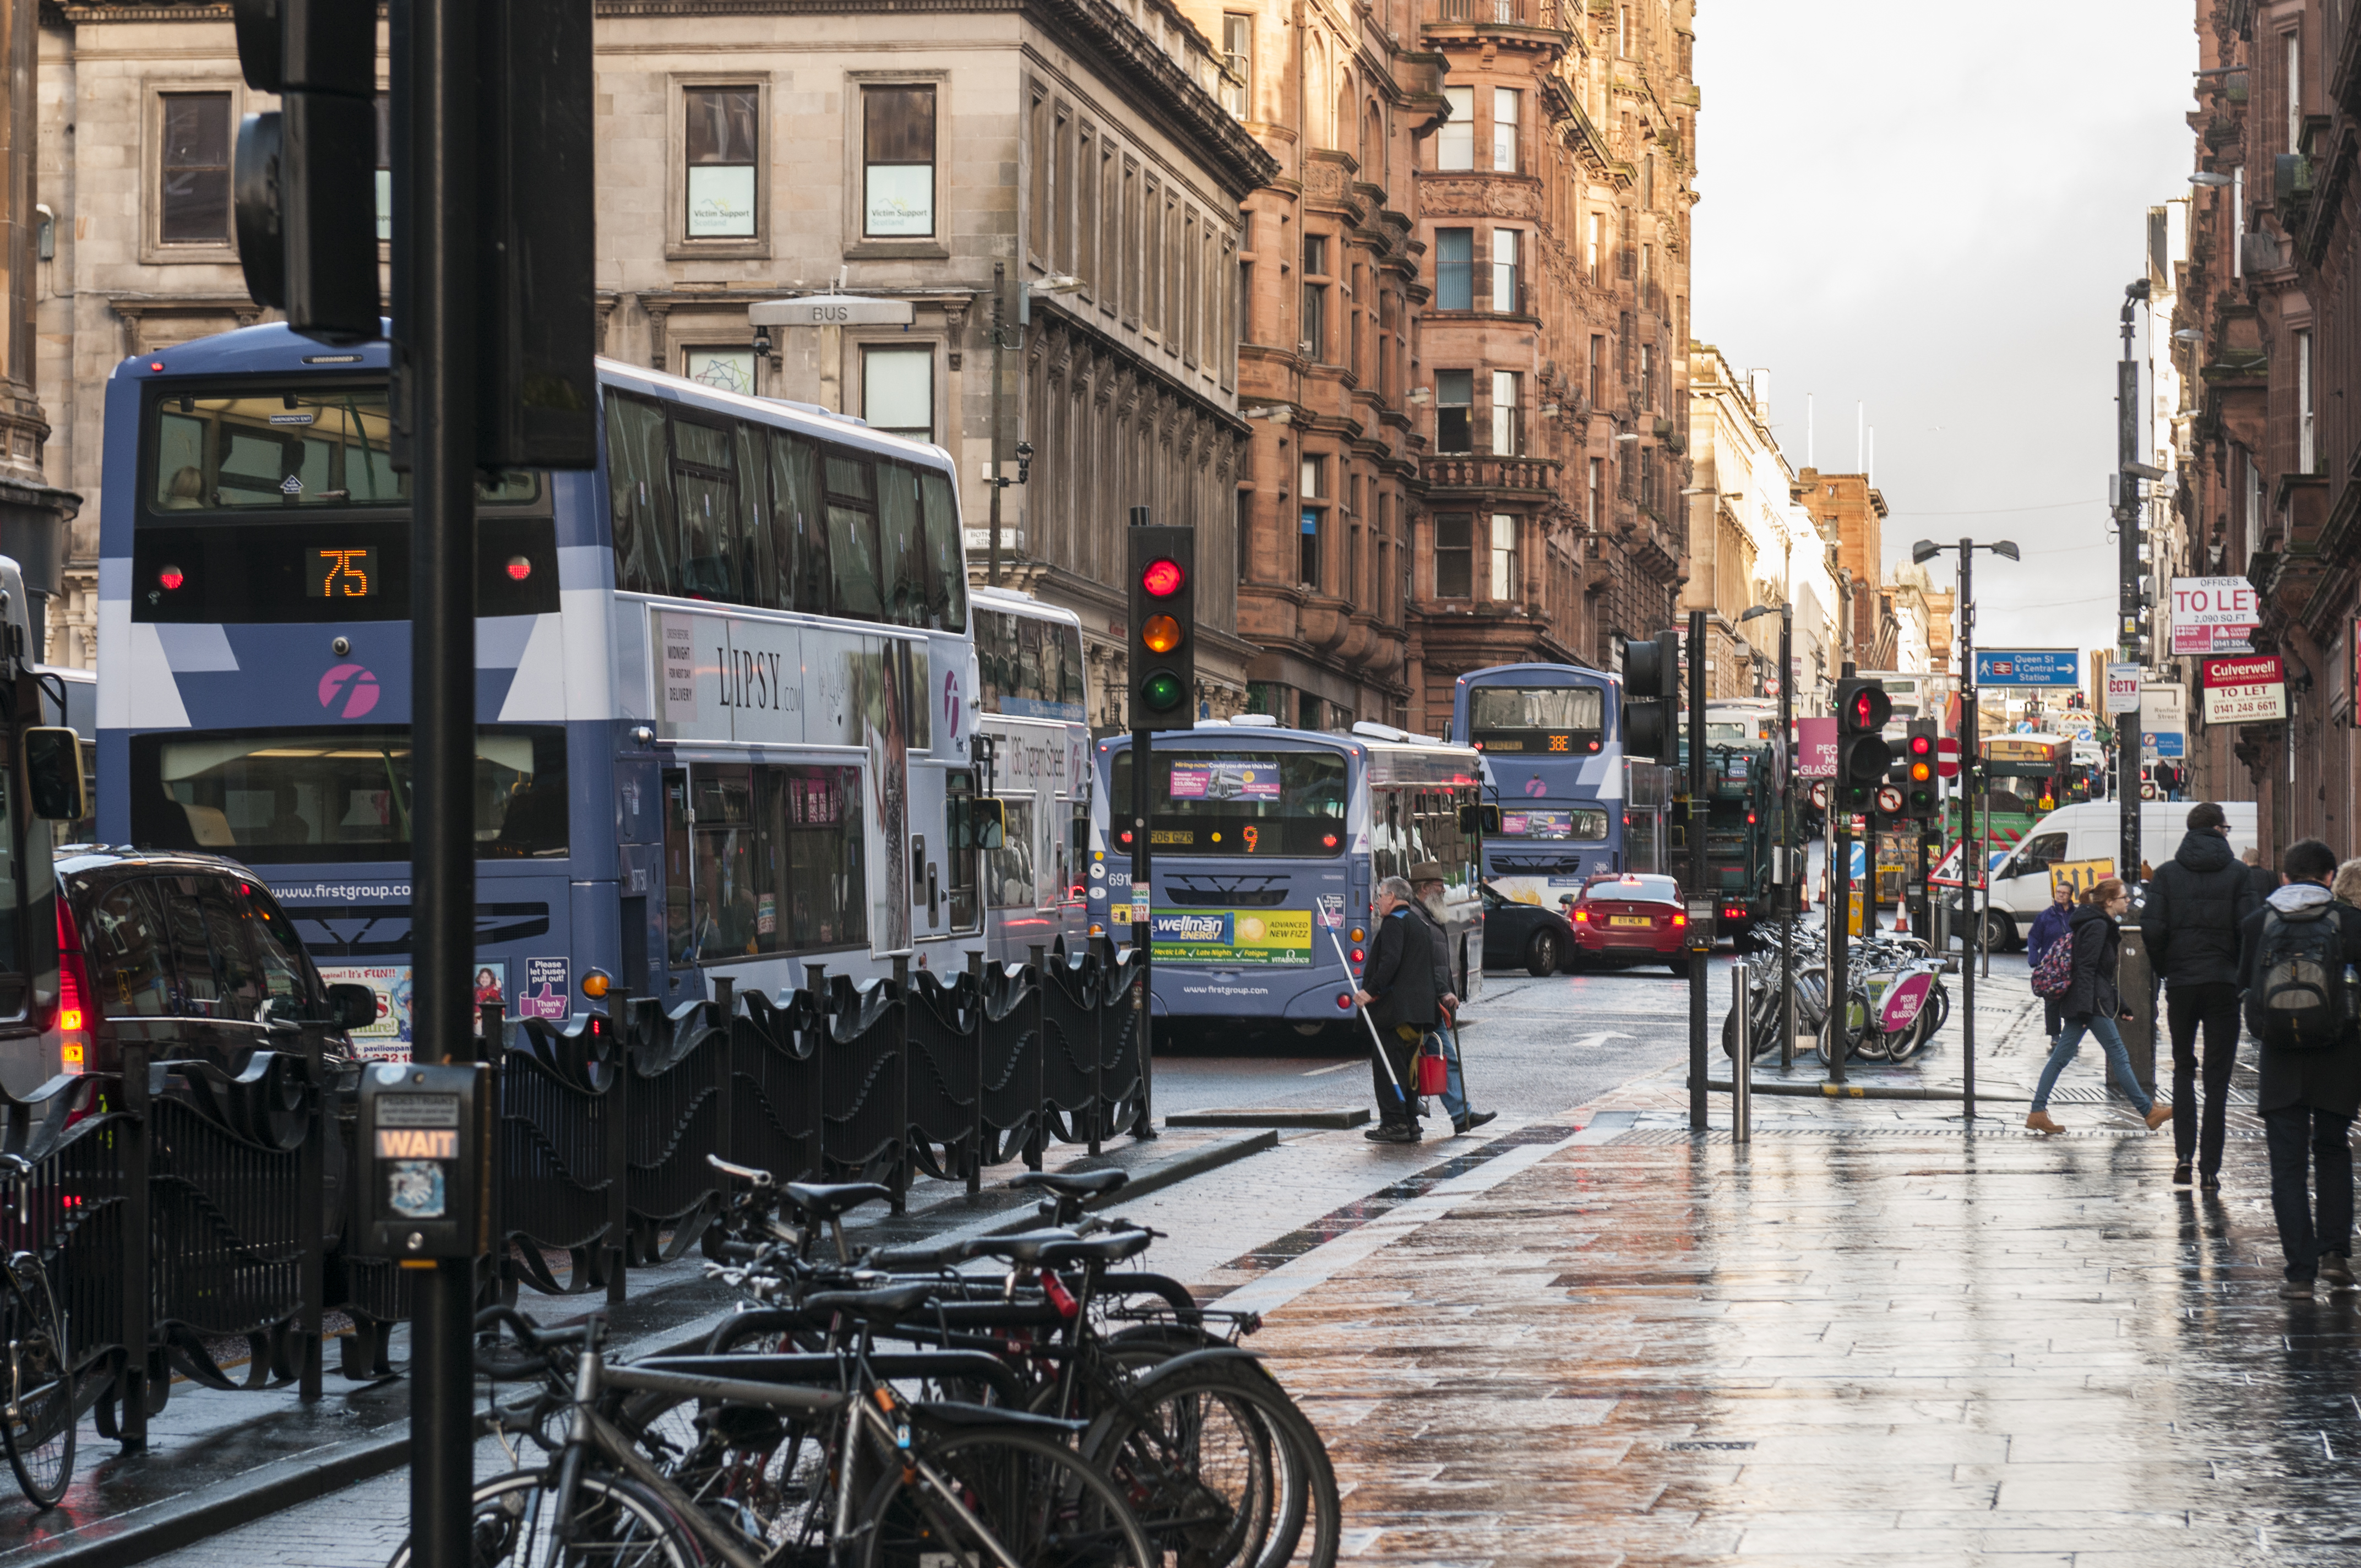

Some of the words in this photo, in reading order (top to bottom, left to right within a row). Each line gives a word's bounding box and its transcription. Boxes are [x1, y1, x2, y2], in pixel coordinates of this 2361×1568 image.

[720, 210, 749, 219] Support
[897, 209, 928, 218] Support
[813, 307, 847, 320] BUS
[320, 551, 367, 597] 75
[2200, 579, 2238, 587] OFFICES
[2174, 590, 2208, 612] TO
[2217, 590, 2259, 611] LET
[2195, 615, 2218, 623] 2,090
[2221, 614, 2246, 622] SQ.FT
[668, 645, 690, 660] MIDNIGHT
[2015, 655, 2042, 663] Queen
[2023, 664, 2054, 672] Central
[2211, 660, 2275, 676] Culverwell
[2109, 680, 2136, 693] CCTV
[2220, 688, 2237, 697] TO
[2244, 686, 2267, 696] LET
[670, 687, 692, 702] DELIVERY
[2214, 704, 2233, 714] 0141
[2237, 703, 2253, 712] 248
[2257, 701, 2276, 710] 6611
[1549, 736, 1569, 750] 38E
[1816, 744, 1837, 754] PEO
[1046, 738, 1065, 777] Street
[1800, 765, 1837, 775] GLASG
[1244, 826, 1258, 852] 9
[272, 884, 411, 900] www.firstgroup.co
[1180, 930, 1220, 940] ENERGY
[1290, 930, 1308, 938] FIZZ
[1211, 949, 1232, 957] Nights
[1244, 950, 1268, 958] Fatigue
[349, 970, 361, 978] It's
[363, 968, 395, 978] FUN!!
[532, 975, 547, 984] pull
[1184, 986, 1268, 996] www.firstgroup.com
[536, 999, 561, 1008] Thank
[1900, 994, 1918, 1003] PEOPLE
[380, 1130, 455, 1157] WAIT
